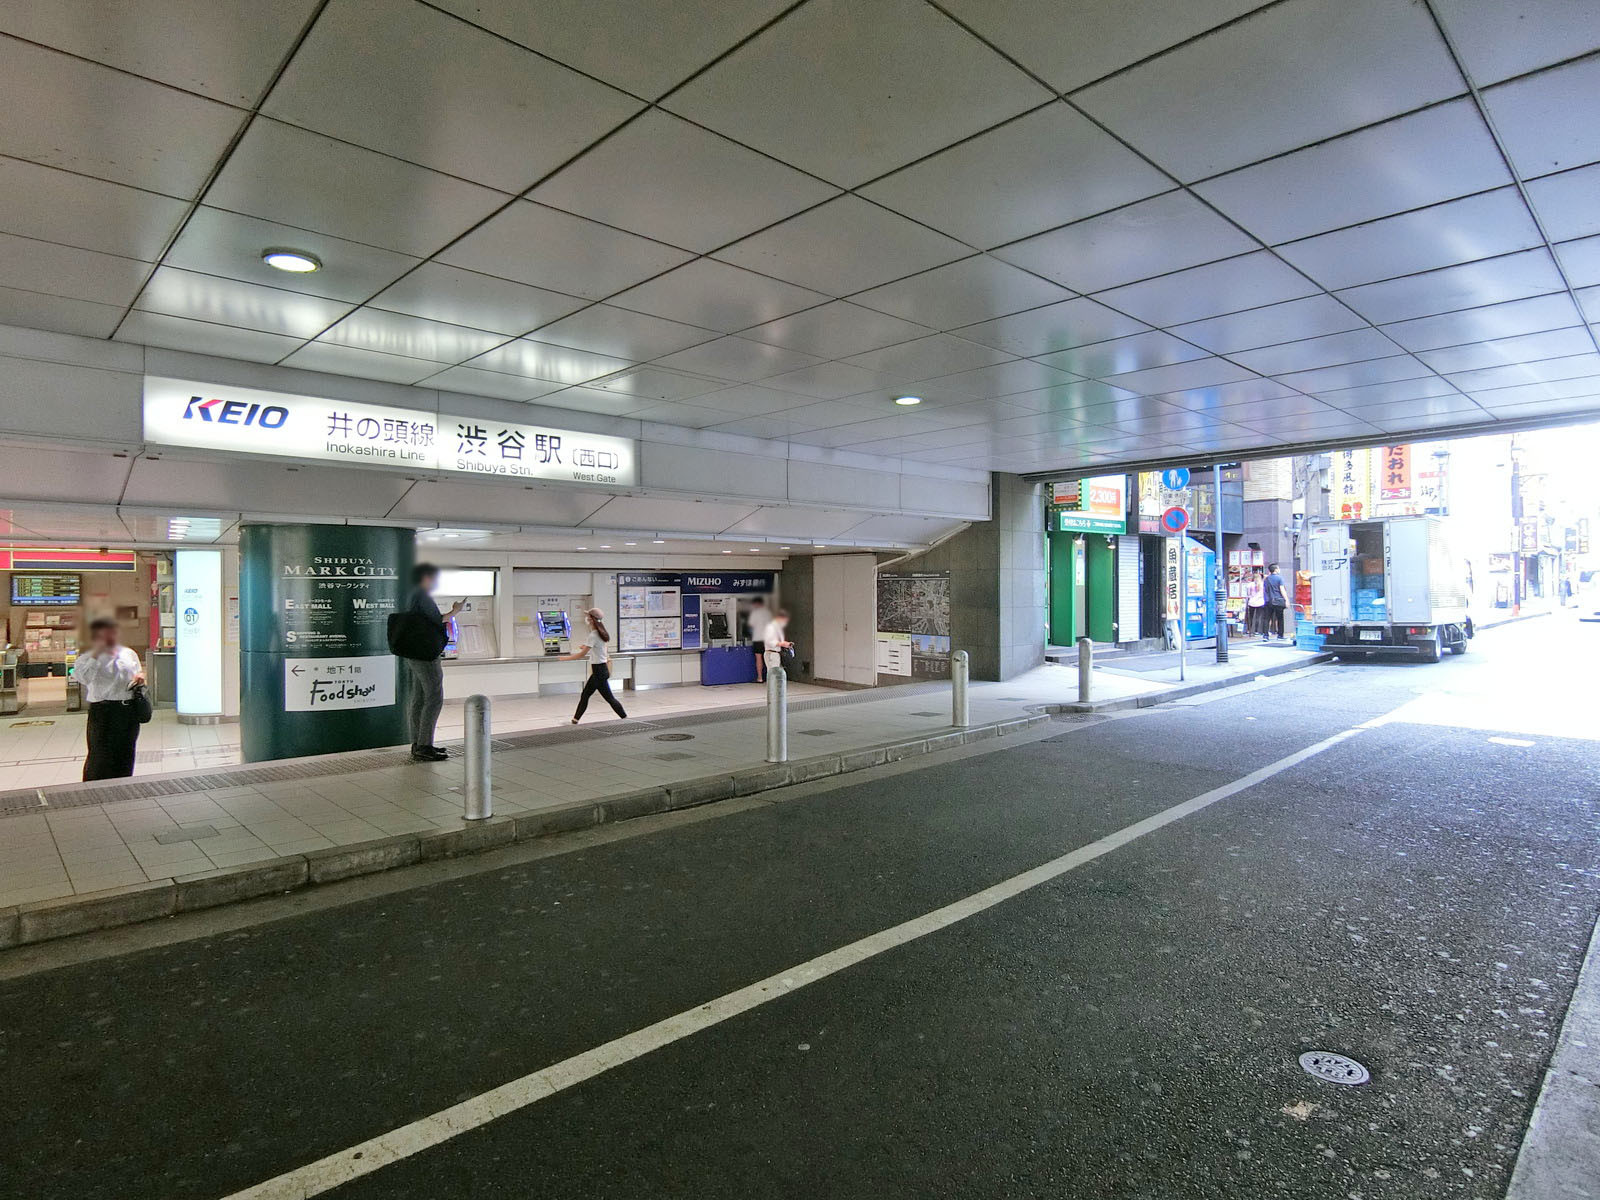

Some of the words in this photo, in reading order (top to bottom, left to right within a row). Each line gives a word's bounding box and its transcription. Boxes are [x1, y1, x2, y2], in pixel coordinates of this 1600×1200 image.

[183, 396, 289, 428] KEIO
[327, 411, 434, 446] 井の頭線
[326, 441, 396, 458] Inokashira
[400, 449, 425, 461] Line
[457, 424, 562, 464] 渋谷駅
[457, 458, 506, 475] Shibuya
[510, 465, 533, 476] Stn.
[573, 472, 595, 481] West
[597, 474, 616, 483] Gate
[314, 556, 373, 565] SHIBUYA
[284, 565, 348, 576] MARK
[353, 565, 397, 576] CITY
[687, 577, 721, 586] MIZUHO
[185, 614, 195, 622] 01
